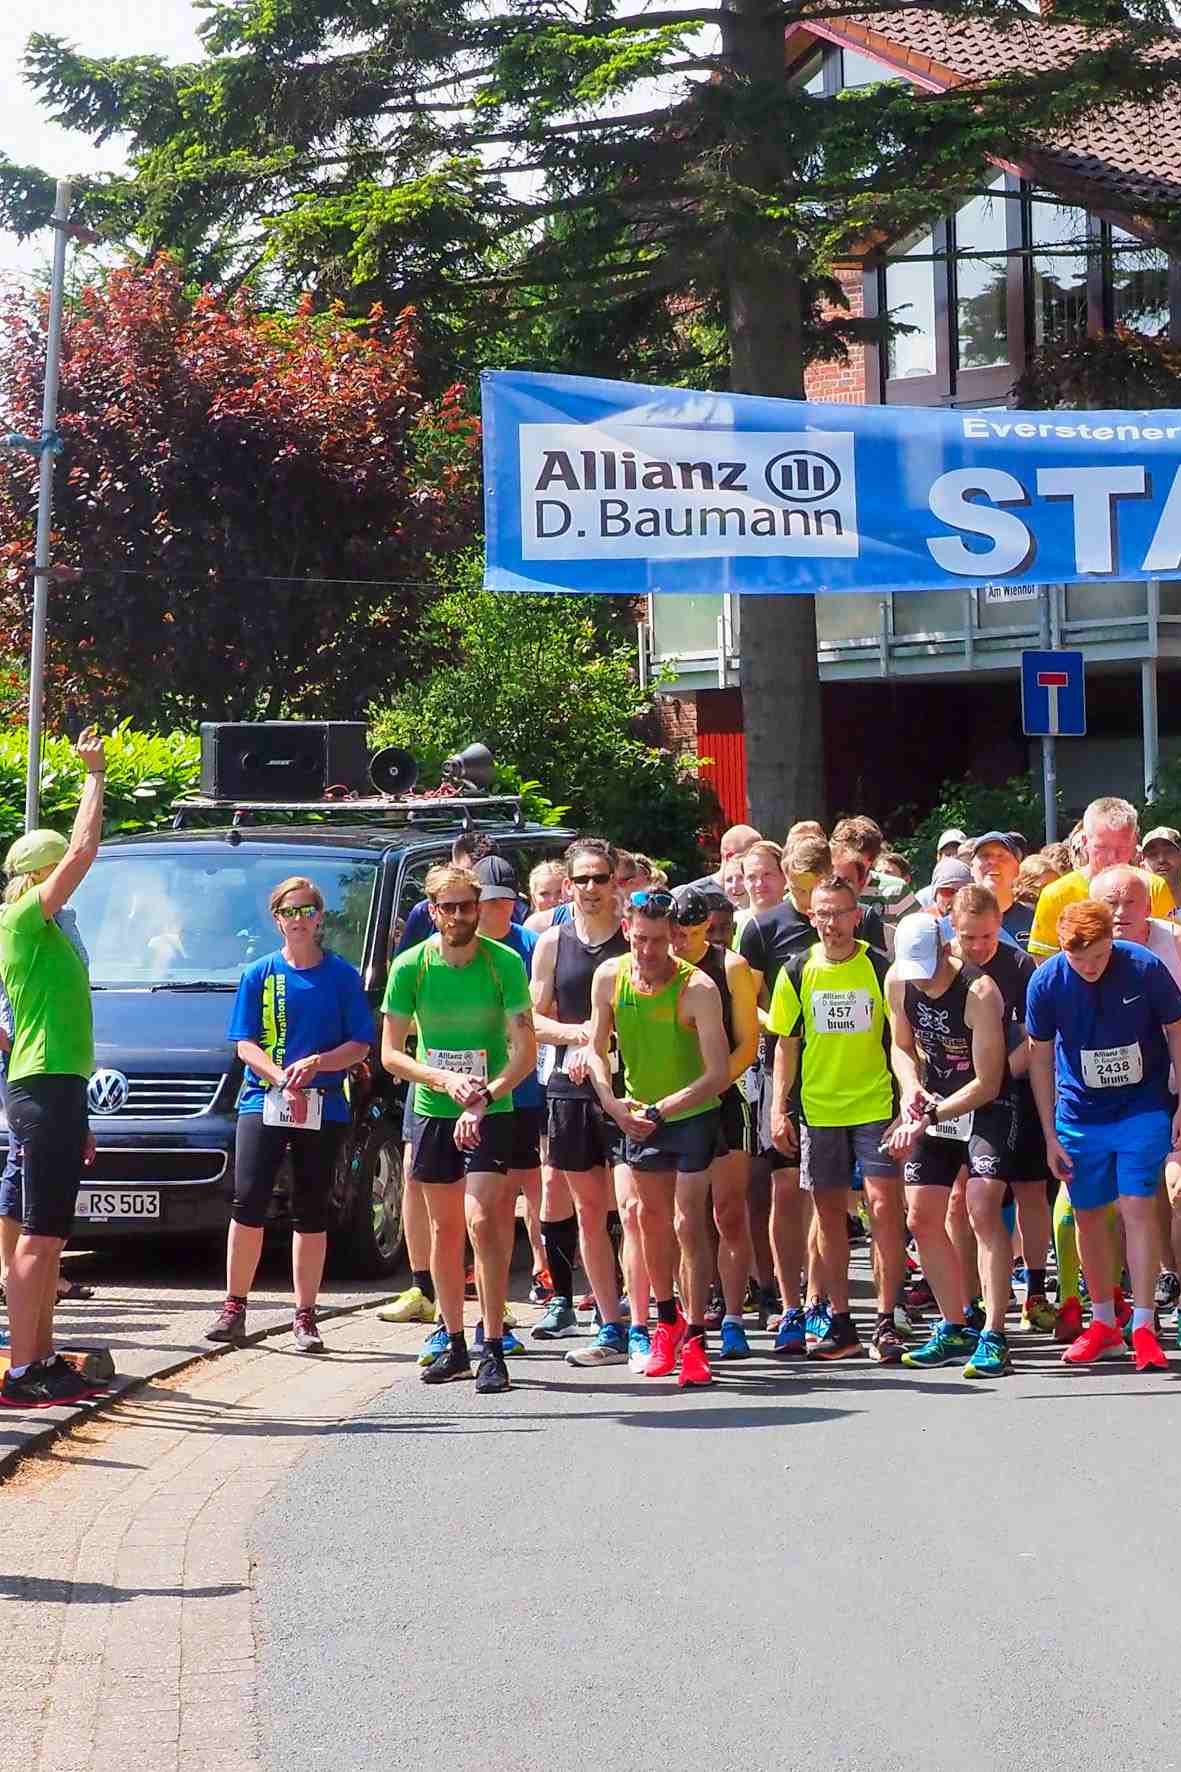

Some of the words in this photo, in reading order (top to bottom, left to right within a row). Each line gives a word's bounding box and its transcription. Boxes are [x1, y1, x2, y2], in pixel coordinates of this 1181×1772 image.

[962, 418, 1181, 441] Everstener
[535, 450, 748, 491] Allianz
[535, 499, 587, 538] D.
[600, 498, 844, 538] Baumann
[828, 1006, 852, 1018] 457
[827, 1019, 855, 1030] bruns
[1096, 1061, 1130, 1076] 2438
[90, 1194, 116, 1214] RS
[120, 1194, 157, 1215] 503
